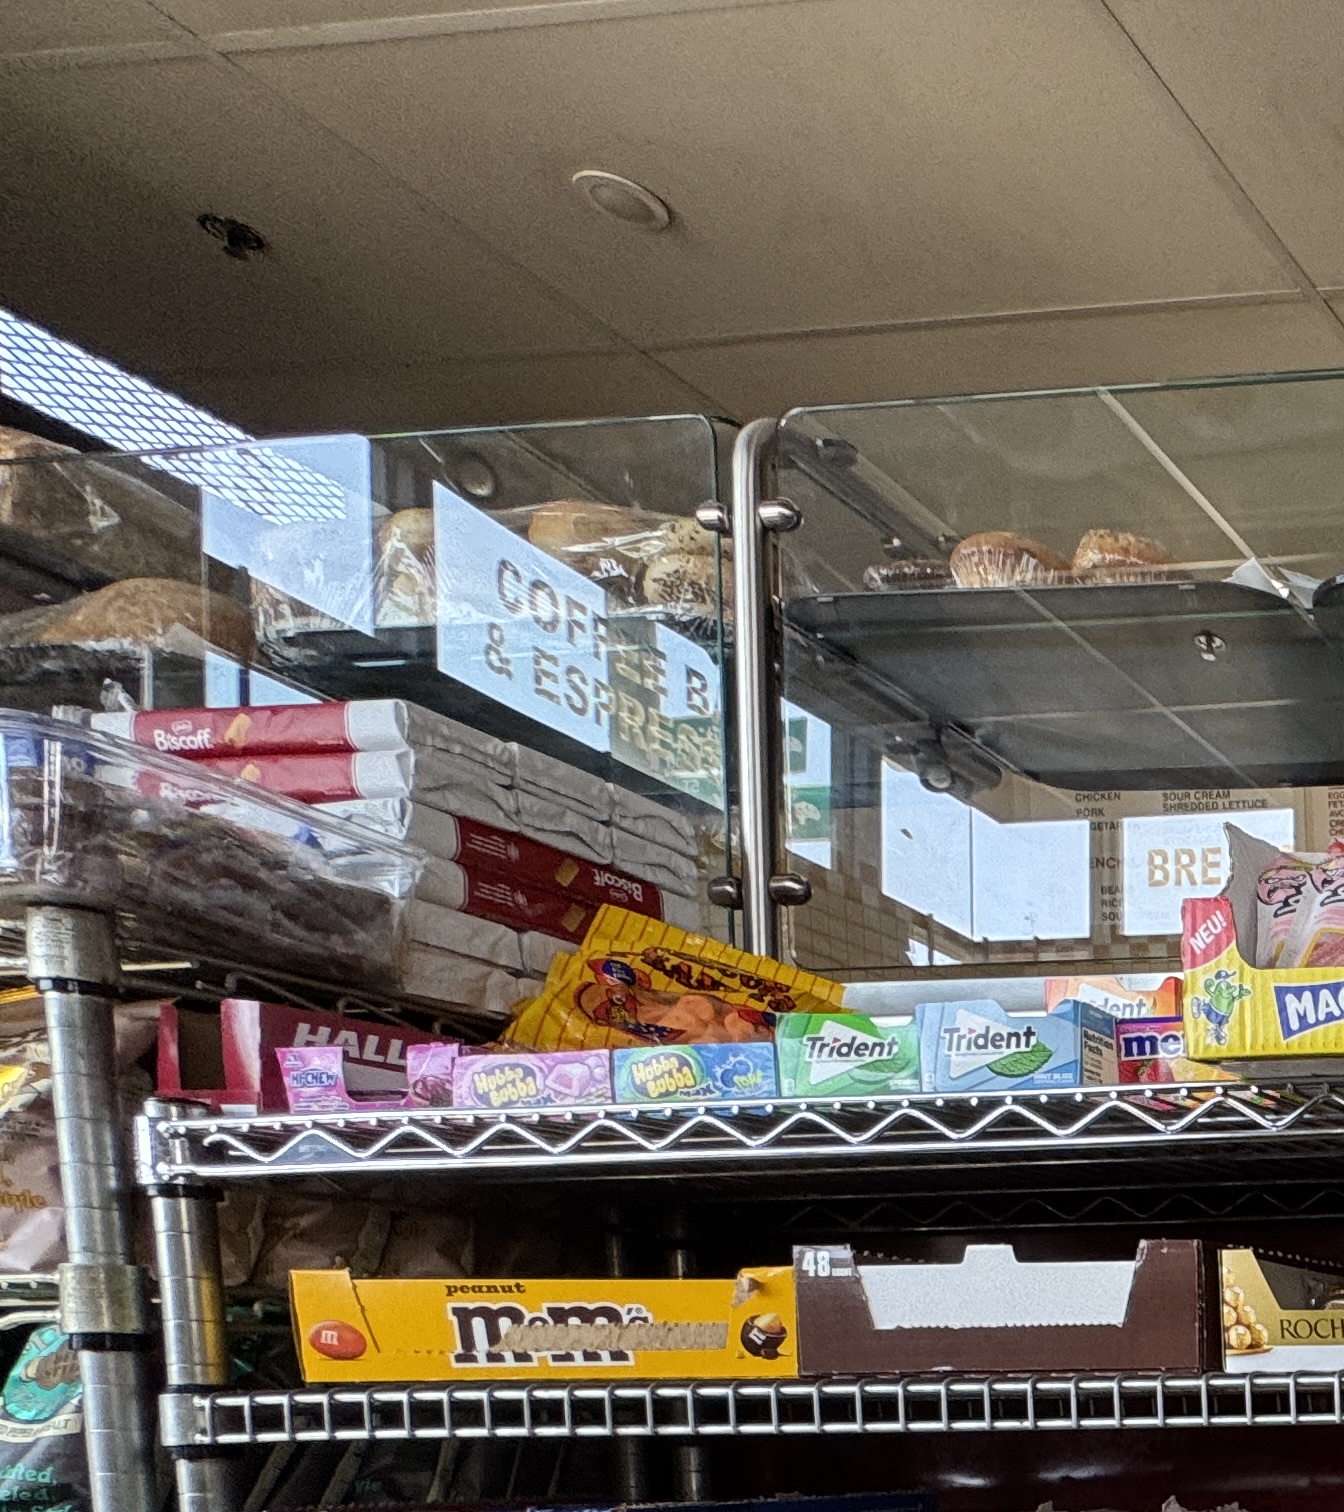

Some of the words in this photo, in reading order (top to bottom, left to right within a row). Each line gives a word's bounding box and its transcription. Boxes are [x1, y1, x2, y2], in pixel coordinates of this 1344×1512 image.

[153, 727, 214, 751] Biscoff
[1075, 793, 1121, 801] CHICKEN
[1162, 792, 1195, 801] SOUR
[1198, 790, 1231, 800] CREAM
[1162, 802, 1218, 812] SHREDDED
[1222, 800, 1268, 809] LETTUCE
[1189, 912, 1228, 954] NEU!
[293, 1022, 407, 1065] HALL
[805, 1032, 898, 1060] Trident
[943, 1025, 1035, 1051] Trident
[291, 1070, 338, 1088] HI-CHEW
[802, 1251, 830, 1277] 48
[445, 1282, 526, 1296] peanut
